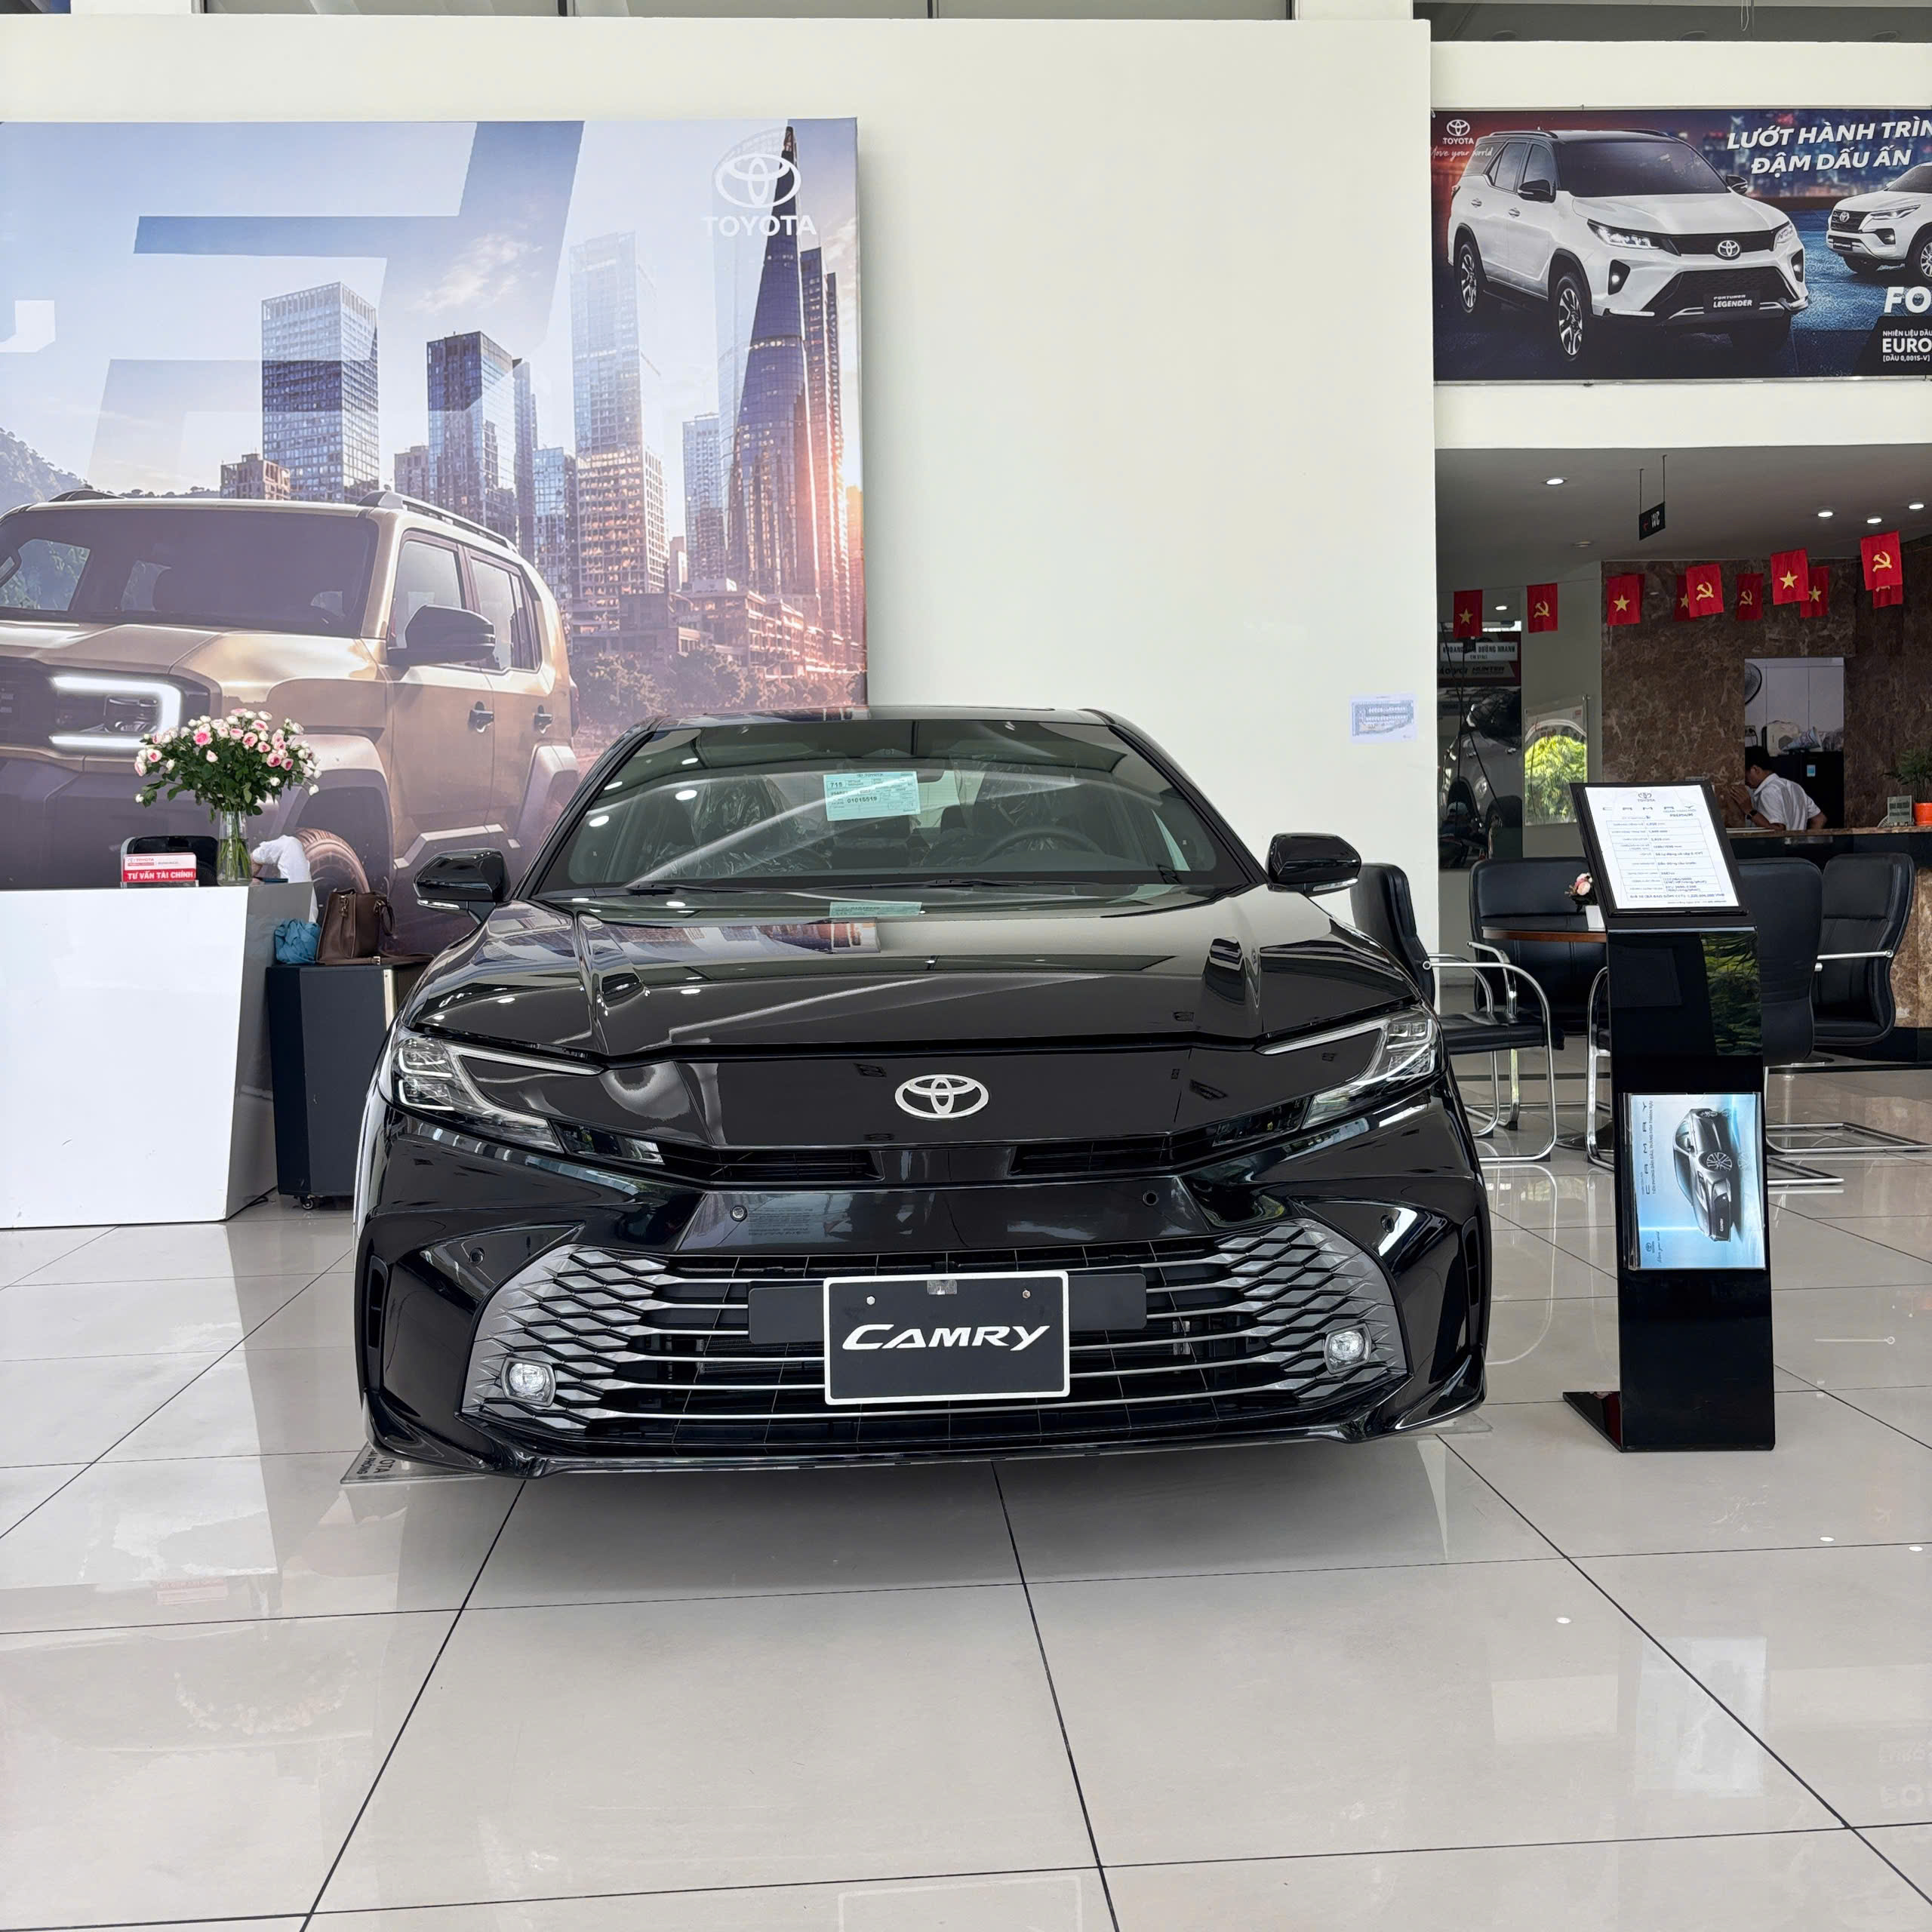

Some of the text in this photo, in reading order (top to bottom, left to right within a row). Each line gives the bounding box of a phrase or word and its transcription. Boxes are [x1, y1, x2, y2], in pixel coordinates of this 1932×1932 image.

[1727, 125, 1794, 149] LƯỚT
[1798, 121, 1875, 144] HÀNH
[1431, 146, 1449, 159] ove
[1450, 151, 1470, 162] your
[1751, 145, 1912, 178] ĐẬM DẤU ẤN
[700, 215, 817, 237] TOYOTA
[1713, 300, 1752, 308] LEGENDER
[1884, 286, 1932, 313] FO
[1904, 329, 1918, 338] LIỆU
[1882, 337, 1932, 353] EURO
[1651, 511, 1660, 528] WC
[127, 869, 194, 880] TƯ VẤN TÀI CHÍNH
[842, 1324, 1051, 1351] CAMRY
